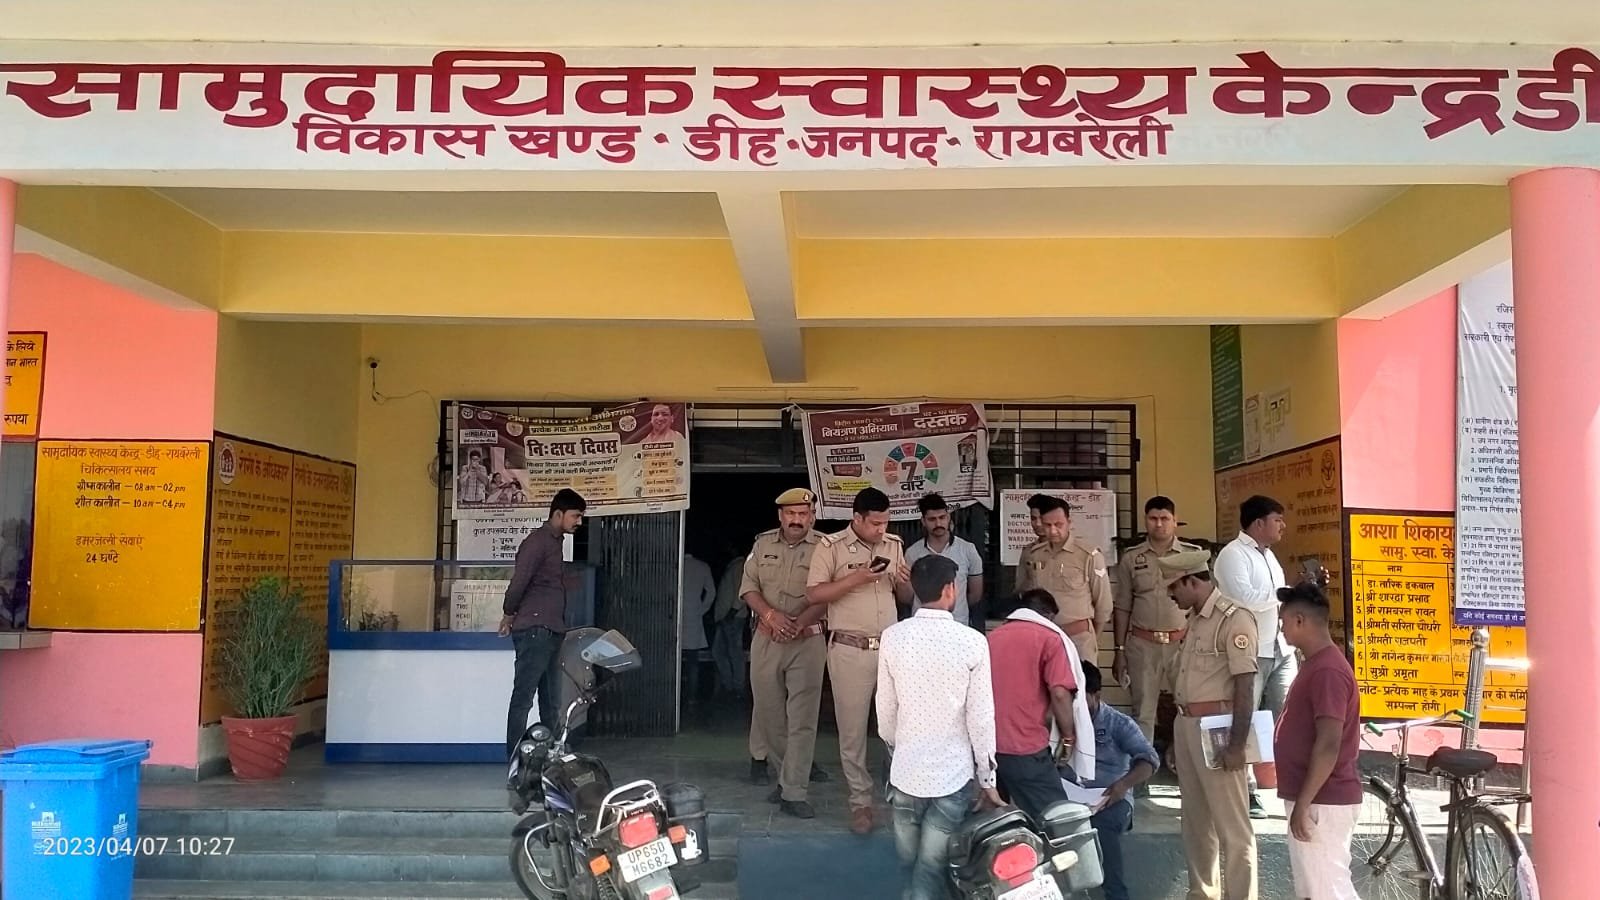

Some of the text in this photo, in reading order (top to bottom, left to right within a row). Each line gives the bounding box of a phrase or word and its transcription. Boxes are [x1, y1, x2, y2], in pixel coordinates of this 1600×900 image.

[0, 51, 696, 126] सामुदायिक
[713, 66, 1196, 121] स्वास्थ्य
[1211, 51, 1509, 139] केन्द्र
[293, 114, 1173, 165] विकास खण्ड डीह जनपद रायबरेली
[912, 413, 968, 429] दस्तक
[580, 438, 618, 455] दिवस
[901, 462, 918, 484] 7
[1359, 519, 1454, 542] आशा शिकाय
[86, 553, 97, 563] 24
[1441, 544, 1455, 560] के
[1366, 589, 1376, 602] श्री
[1366, 604, 1376, 614] श्री
[1366, 618, 1389, 630] श्रीमती
[1367, 632, 1393, 645] श्रीमती
